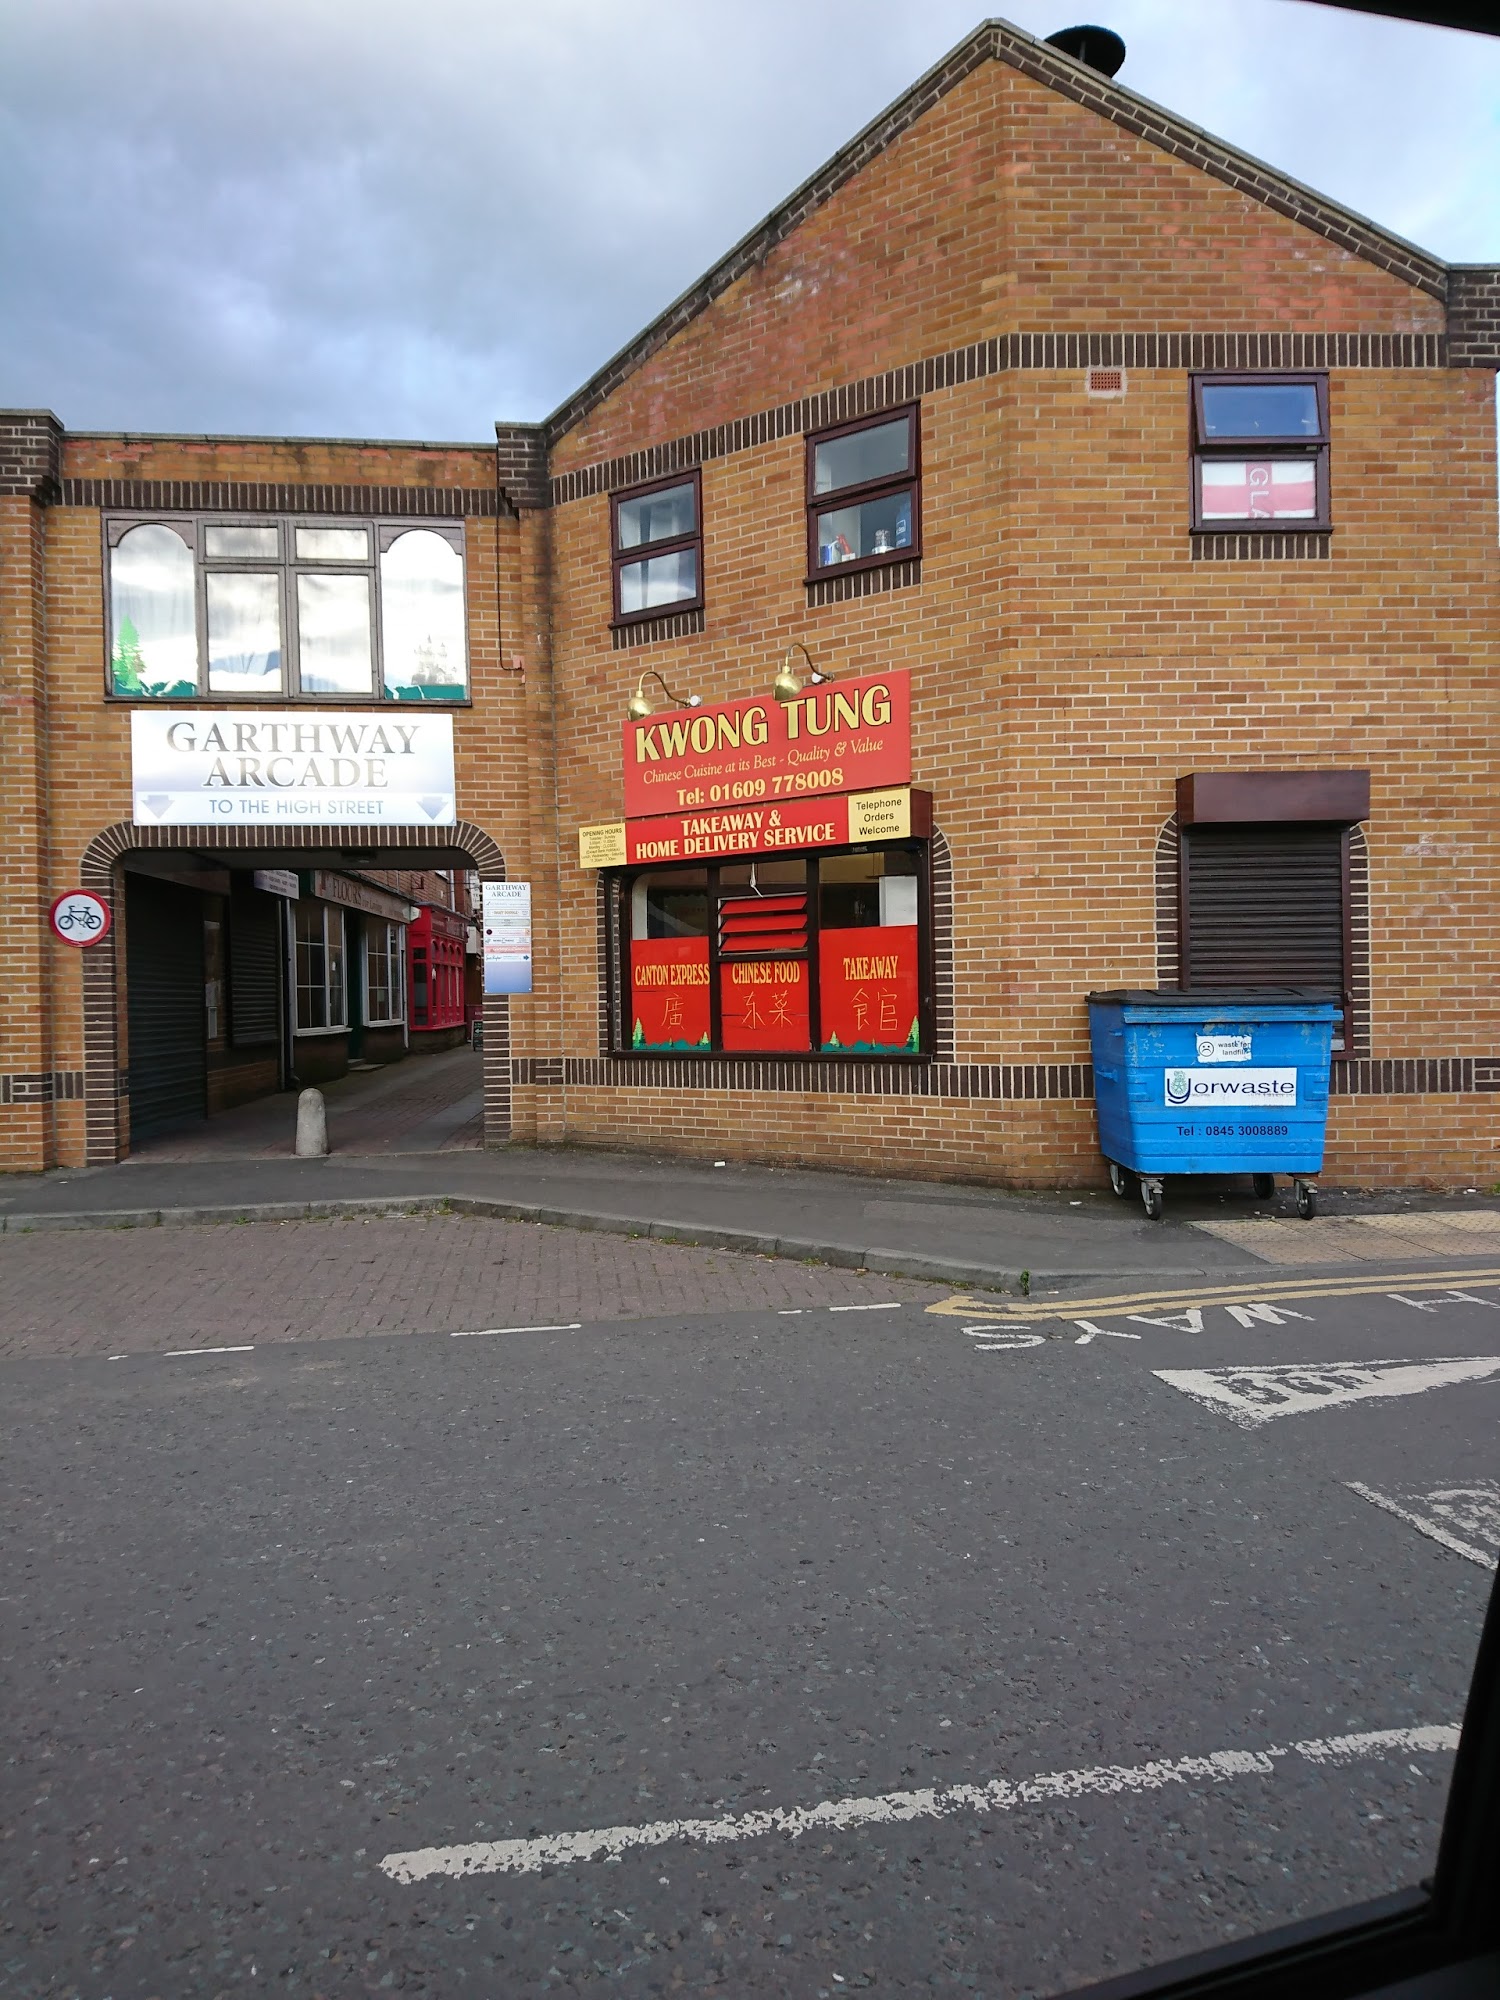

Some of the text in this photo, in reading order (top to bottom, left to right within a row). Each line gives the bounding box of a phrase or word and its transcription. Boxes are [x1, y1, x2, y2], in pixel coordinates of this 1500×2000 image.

[635, 684, 892, 764] KWONG TUNG
[166, 722, 421, 754] GARTHWAY
[202, 756, 389, 788] ARCADE
[643, 769, 682, 784] Chinese
[684, 763, 722, 780] Cuisine
[725, 761, 736, 773] at
[738, 758, 750, 771] its
[753, 754, 776, 769] Best
[787, 745, 830, 767] Quality
[834, 741, 846, 757] &
[850, 737, 883, 753] Value
[677, 767, 844, 806] Tel: 01609 778008
[209, 799, 384, 815] TO THE HIGH STREET
[856, 798, 902, 812] Telephone
[864, 811, 894, 823] Orders
[681, 809, 781, 836] TAKEAWAY &
[859, 823, 900, 836] Welcome
[636, 822, 836, 859] HOME DELIVERY SERVICE
[333, 877, 362, 906] FLOORS
[635, 963, 710, 986] CANTON EXPRESS
[732, 961, 800, 985] CHINESE FOOD
[843, 955, 898, 981] TAKEAWAY
[1205, 1126, 1234, 1136] 0845
[1238, 1126, 1288, 1136] 3008889
[961, 1303, 1316, 1350] WAYS
